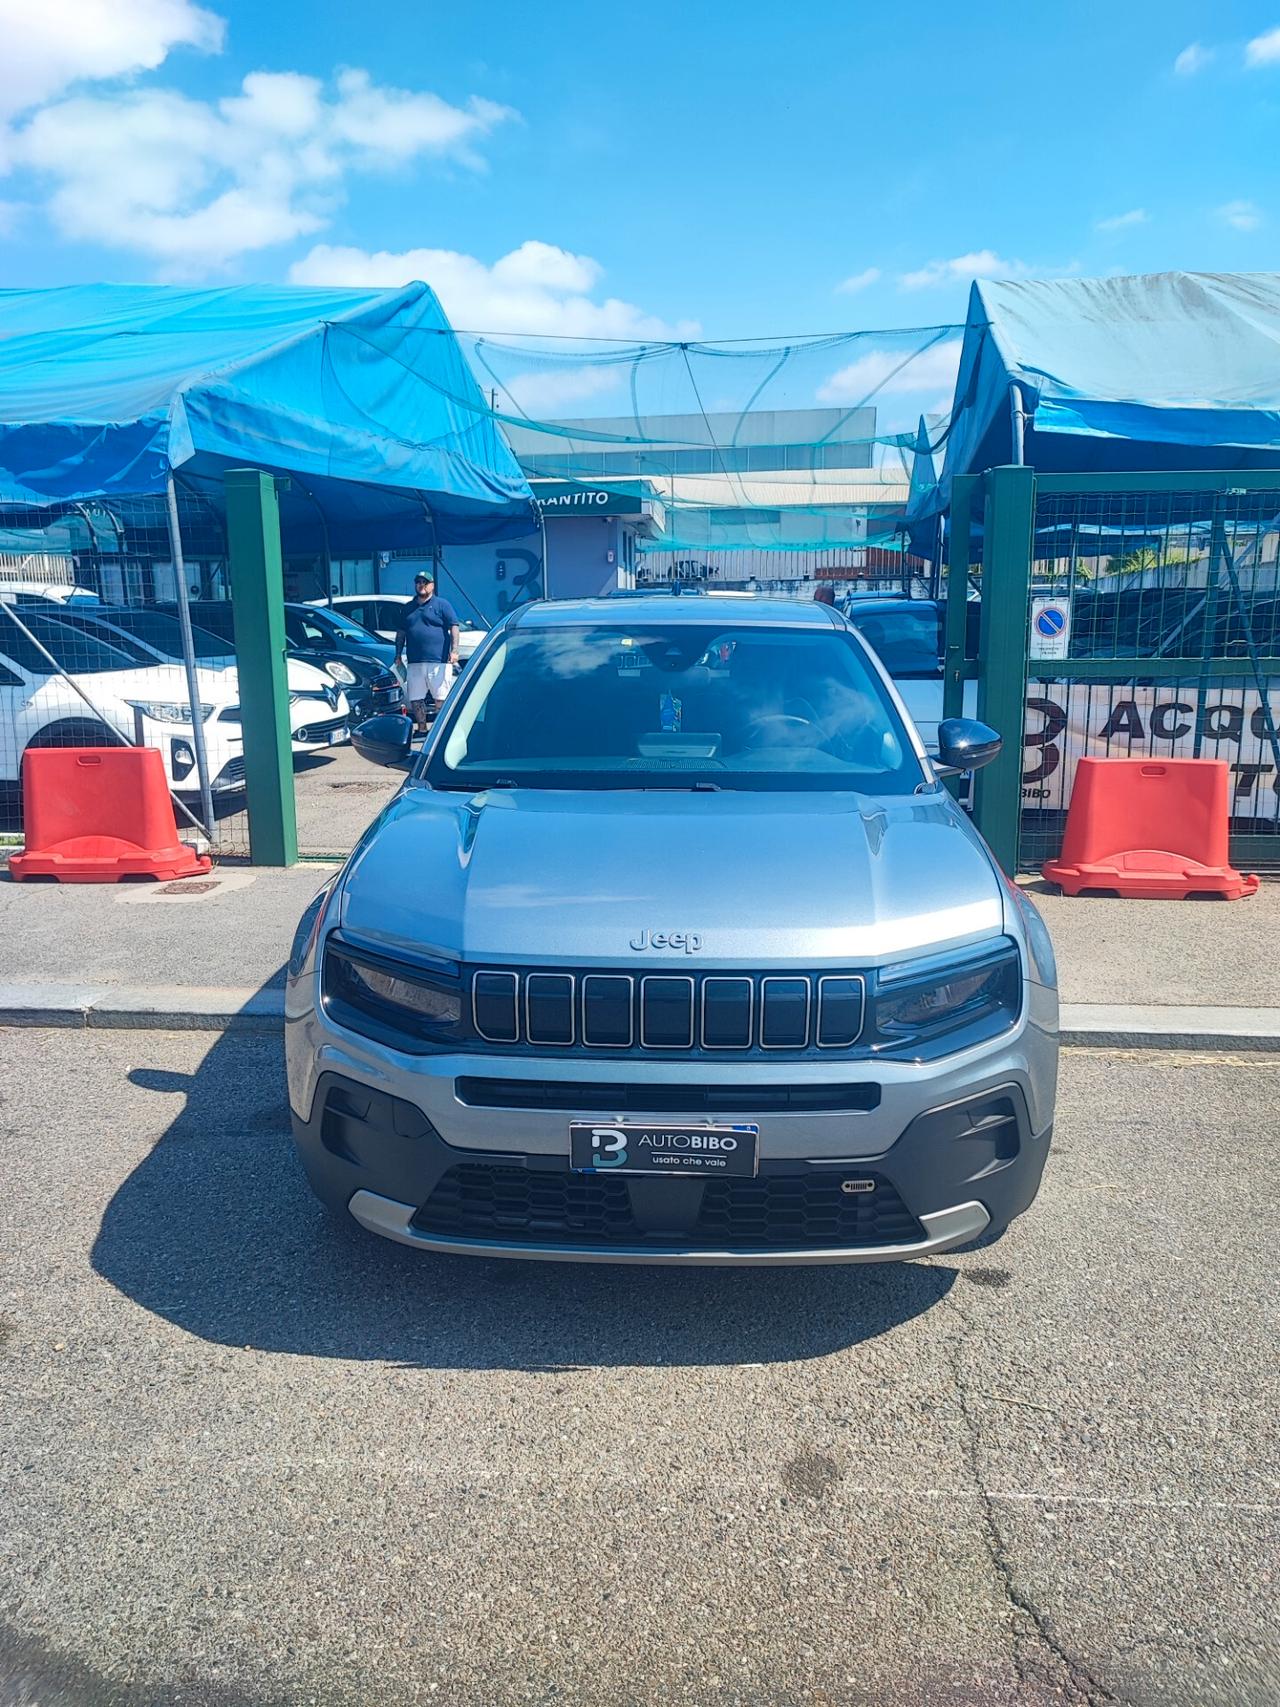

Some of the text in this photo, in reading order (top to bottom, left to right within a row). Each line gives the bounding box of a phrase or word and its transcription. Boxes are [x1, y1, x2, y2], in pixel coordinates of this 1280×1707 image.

[629, 929, 705, 955] Jeep
[637, 1134, 738, 1151] AUTOBIBO
[652, 1156, 727, 1168] usato che vale
